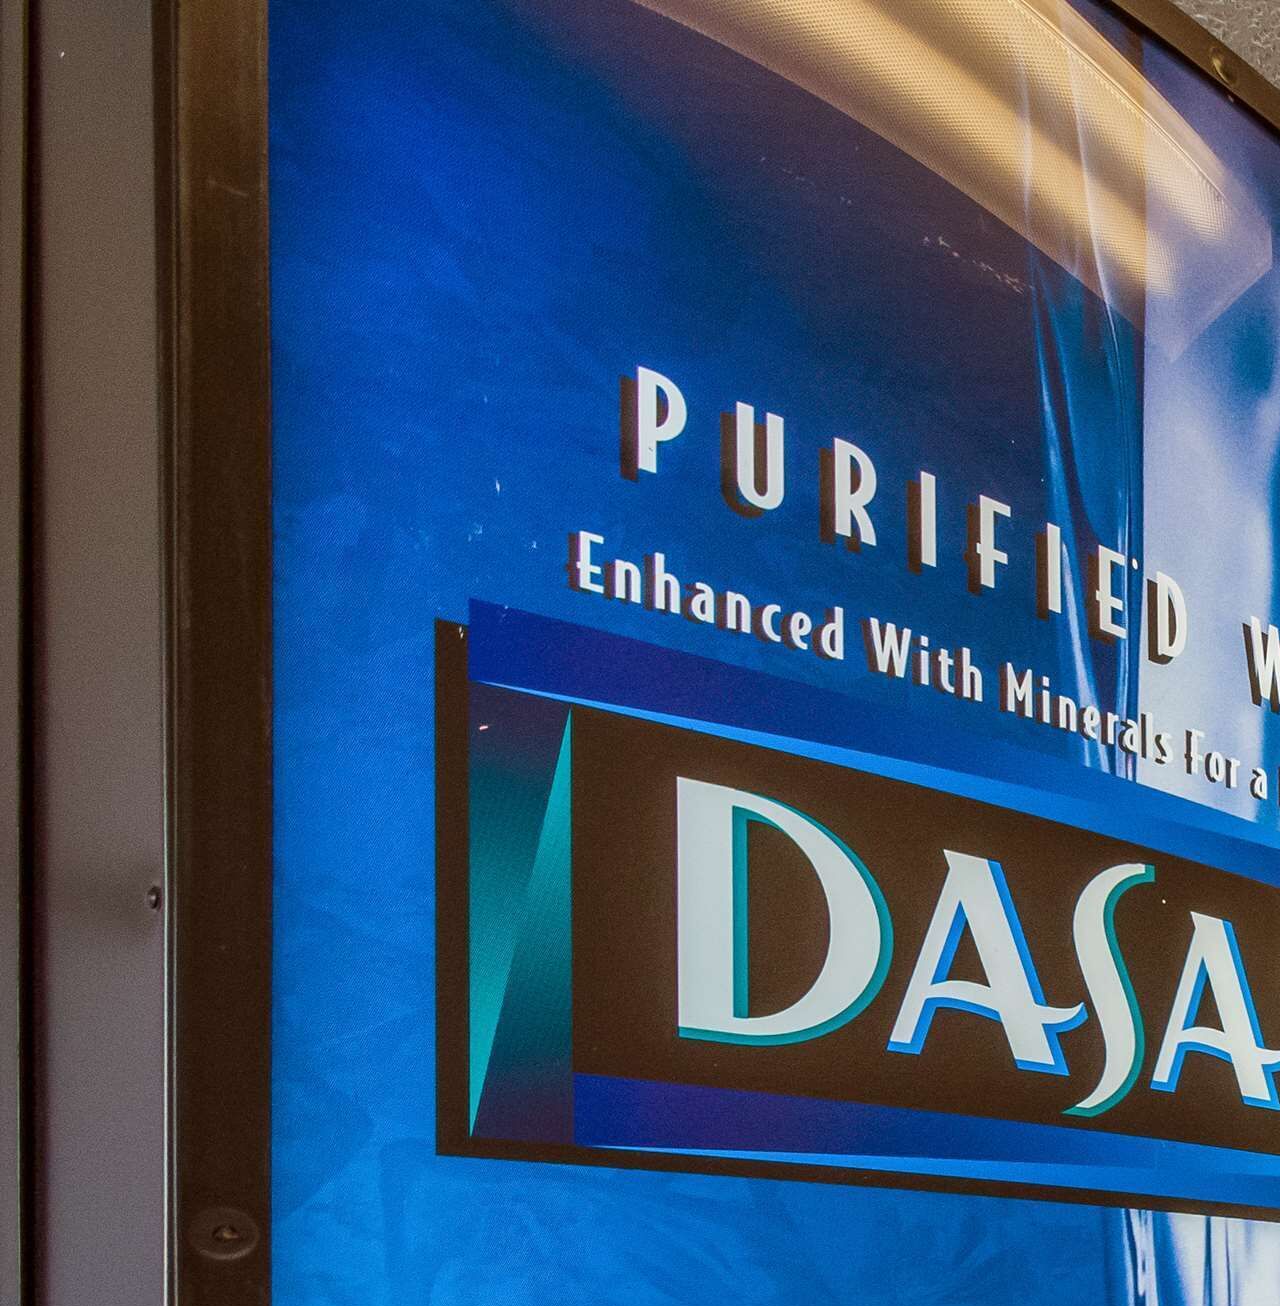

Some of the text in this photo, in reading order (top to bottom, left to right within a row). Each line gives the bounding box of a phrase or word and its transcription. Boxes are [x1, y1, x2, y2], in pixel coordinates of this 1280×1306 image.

[624, 364, 1188, 660] PURIFIED
[574, 529, 844, 660] Enhanced
[866, 616, 983, 702] With
[1004, 661, 1174, 765] Minerals
[1186, 727, 1241, 789] For
[1252, 767, 1269, 800] a
